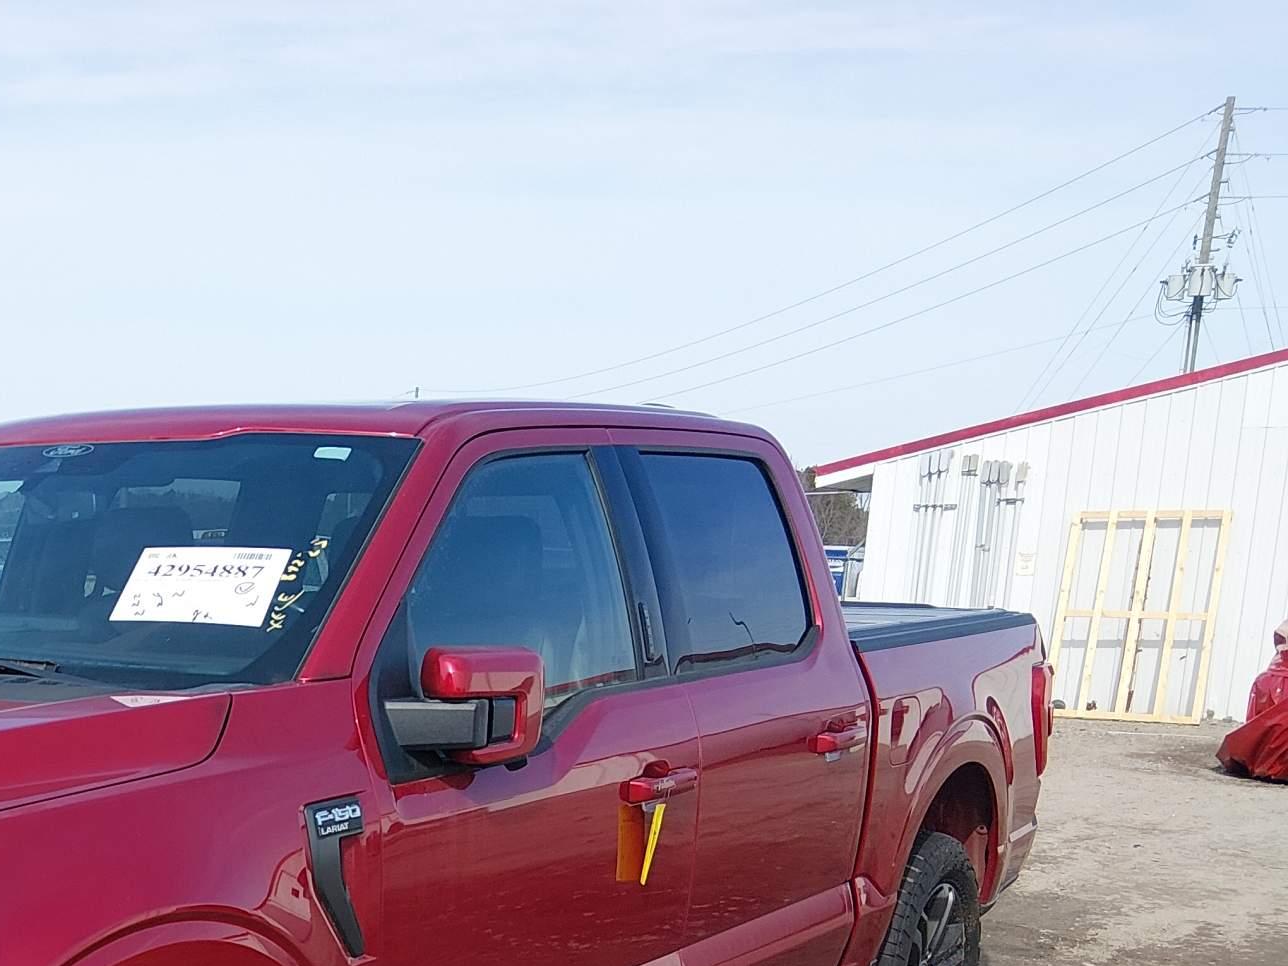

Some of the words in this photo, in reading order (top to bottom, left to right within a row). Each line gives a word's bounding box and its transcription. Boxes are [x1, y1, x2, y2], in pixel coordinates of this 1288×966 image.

[146, 563, 265, 579] 42954887
[315, 803, 361, 826] F-150
[320, 822, 349, 836] LARIAT
